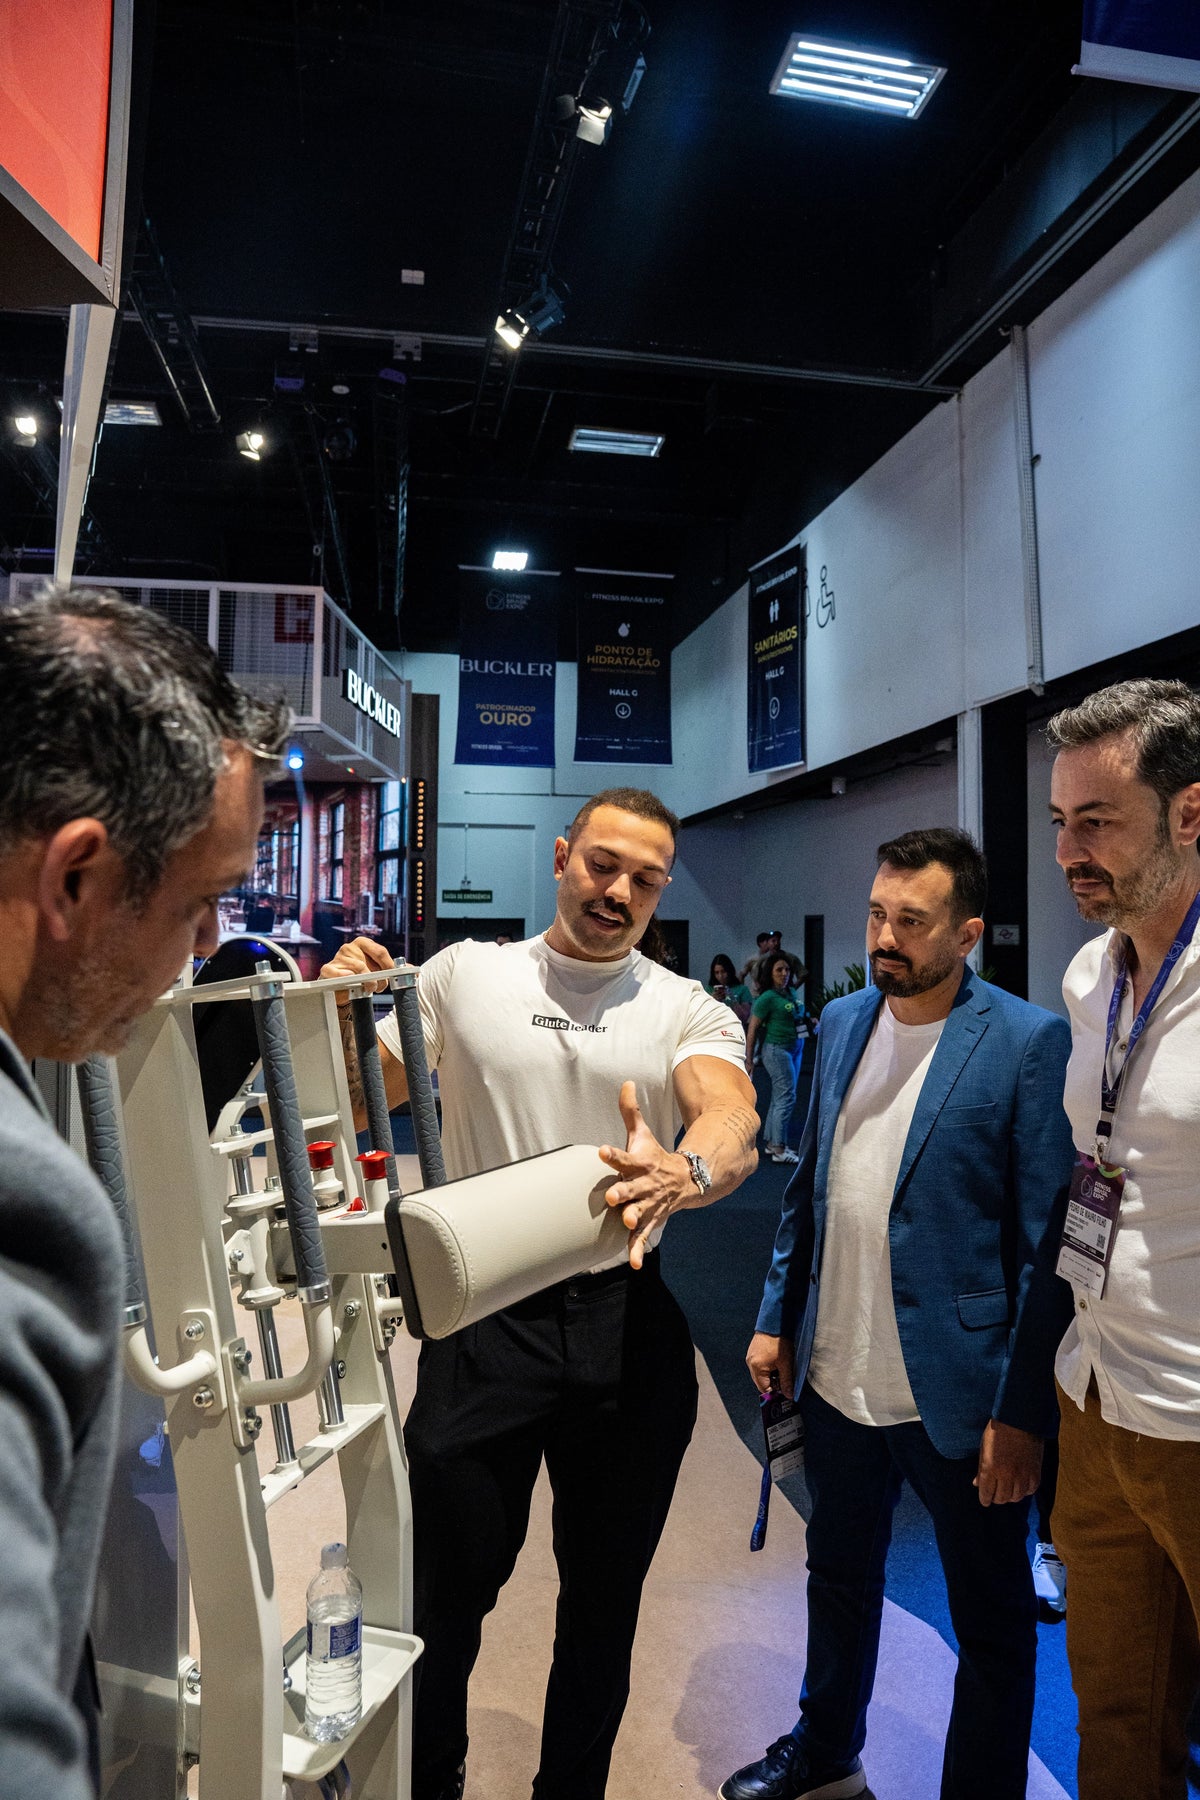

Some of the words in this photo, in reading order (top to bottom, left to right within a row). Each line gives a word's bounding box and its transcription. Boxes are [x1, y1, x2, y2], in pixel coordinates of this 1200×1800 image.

[754, 625, 798, 655] SANITÁRIOS
[595, 645, 634, 656] PONTO
[637, 647, 653, 657] DE
[460, 658, 553, 677] BUCKLER
[586, 654, 661, 669] HIDRATAÇÃO
[765, 668, 779, 681] HALL
[779, 665, 785, 676] G
[609, 688, 630, 697] HALL
[631, 689, 639, 697] G
[347, 668, 401, 739] BUCKLER
[475, 704, 536, 713] PATROCINADOR
[479, 711, 532, 727] OURO
[534, 1016, 568, 1029] Glute
[571, 1023, 608, 1033] leader
